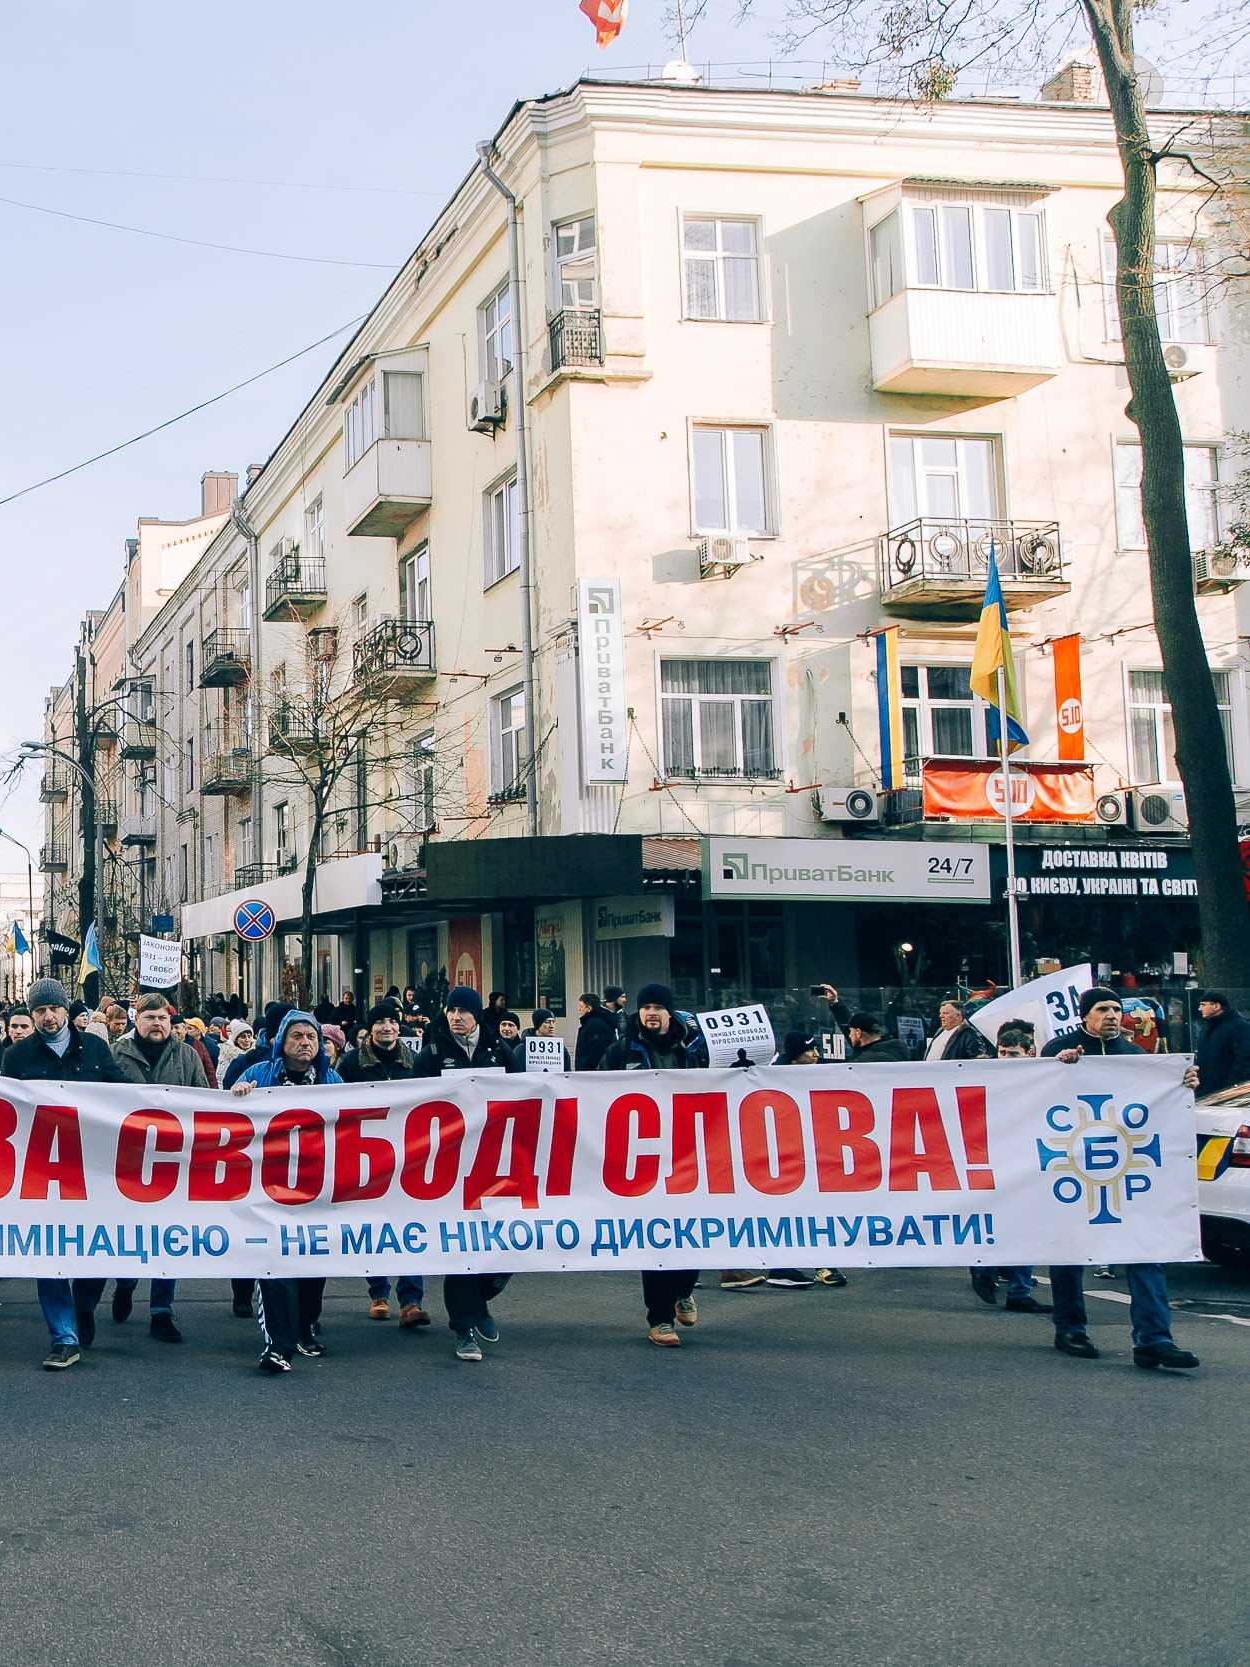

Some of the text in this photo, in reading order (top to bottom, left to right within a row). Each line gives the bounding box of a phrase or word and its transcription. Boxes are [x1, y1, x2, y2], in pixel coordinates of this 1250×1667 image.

[595, 619, 615, 770] ПриватБанк
[1061, 705, 1081, 727] 5.10
[994, 779, 1028, 803] 510
[751, 857, 974, 884] ПриватБанк 24/7
[1041, 850, 1168, 869] ДОСТАВКА КВІТІВ
[1030, 878, 1081, 896] КИЄВУ,
[1140, 878, 1160, 895] ТА
[149, 965, 174, 974] СВОБО
[706, 1010, 764, 1030] 0931
[529, 1040, 561, 1054] 0931
[115, 1098, 579, 1211] СВОБОДІ
[602, 1085, 996, 1198] СЛОВА!
[280, 1223, 328, 1257] НЕ
[341, 1221, 428, 1255] МАЄ
[440, 1217, 580, 1253] НІКОГО
[591, 1213, 996, 1257] ДИСКРИМІНУВАТИ!
